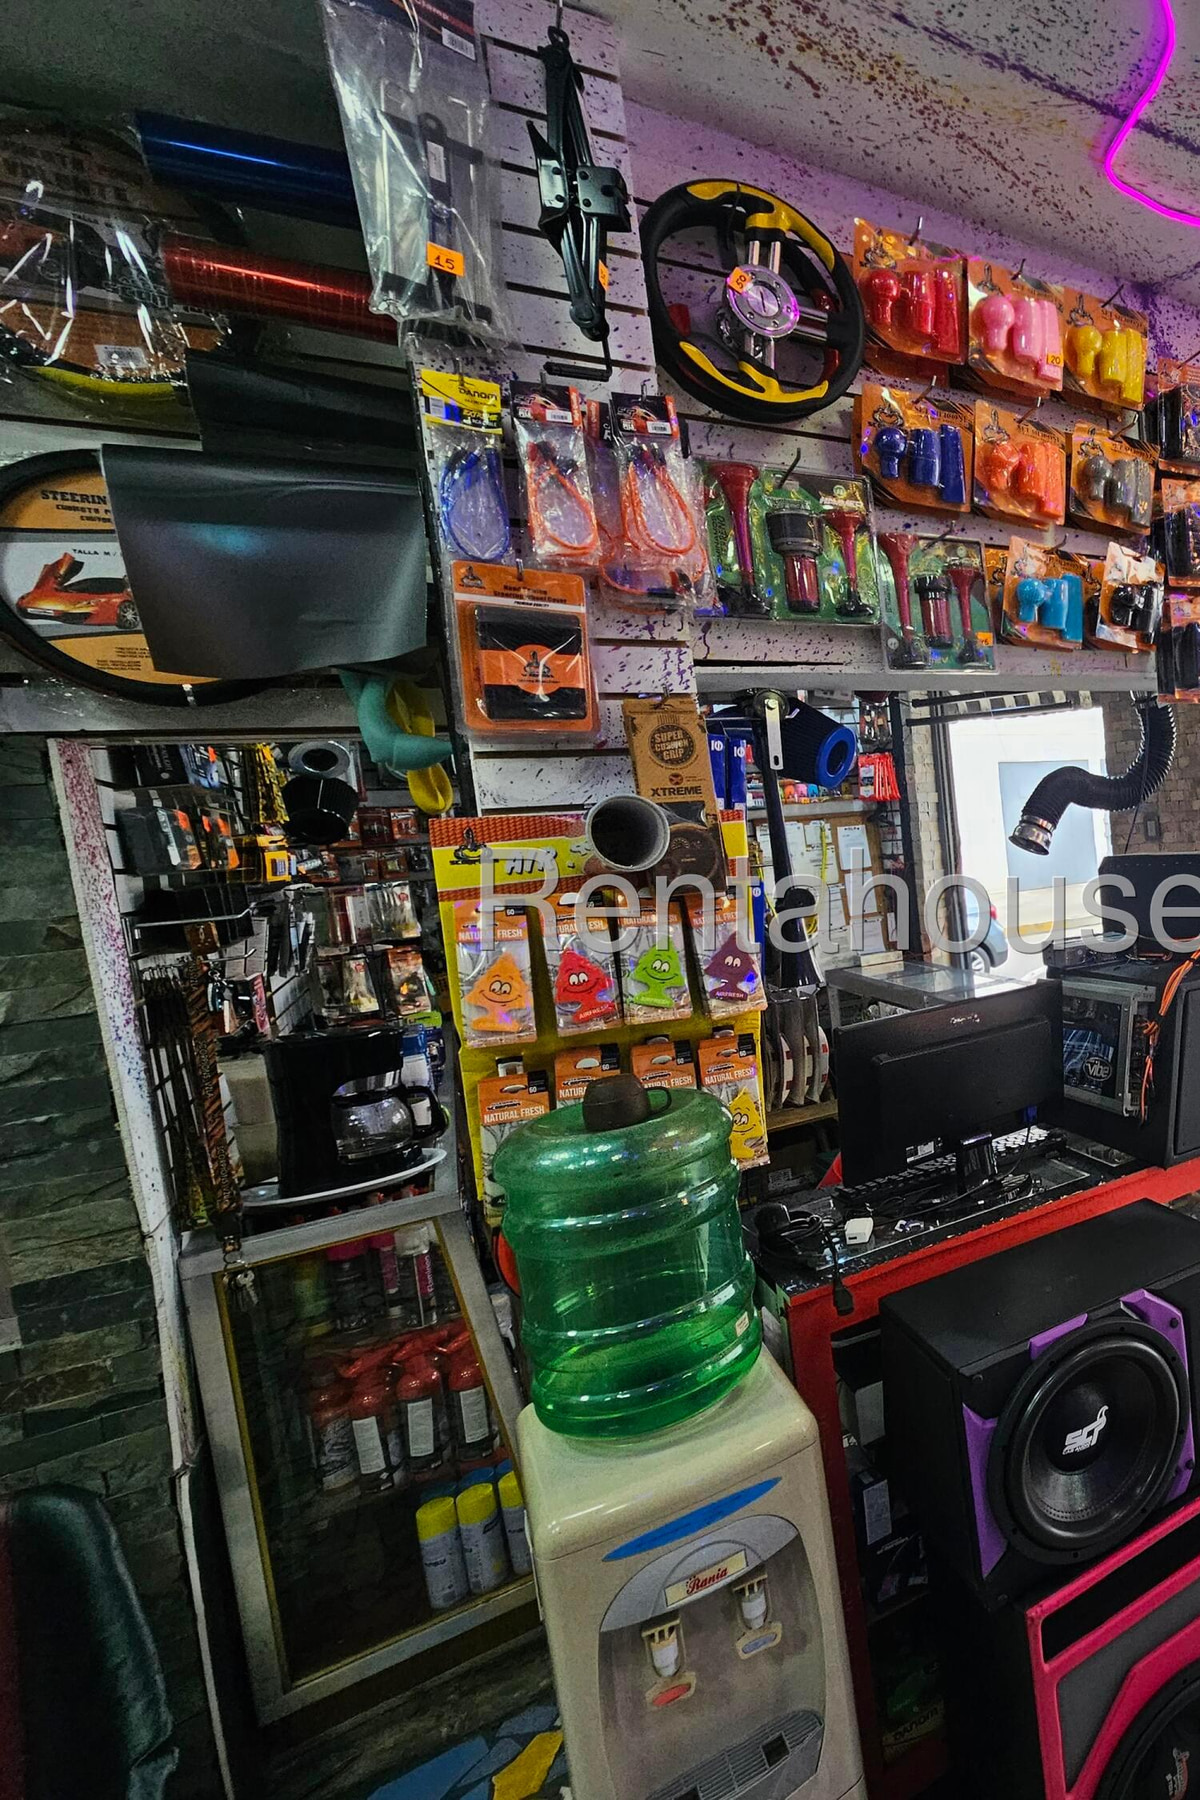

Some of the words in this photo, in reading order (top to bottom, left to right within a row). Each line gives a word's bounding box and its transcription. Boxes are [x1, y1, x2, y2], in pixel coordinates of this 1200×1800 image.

[433, 254, 455, 270] 15
[735, 274, 747, 290] 50
[1050, 355, 1061, 365] 20
[458, 386, 498, 400] DANOM
[41, 489, 108, 506] STEERIN
[72, 548, 99, 556] TALLA
[654, 729, 684, 743] SUPER
[662, 749, 685, 761] GRIP
[651, 785, 703, 797] XTREME
[692, 914, 722, 926] NATAL
[459, 929, 495, 943] NATU
[497, 928, 523, 939] FRESH
[715, 991, 744, 999] AIRFRESH
[704, 1071, 734, 1085] NATURAL
[734, 1065, 754, 1080] FRESH
[1086, 1060, 1110, 1078] vibe
[671, 1075, 692, 1087] FRESH
[559, 1086, 587, 1098] NATURA
[484, 1109, 519, 1124] NATURAL
[520, 1105, 545, 1118] FRESH
[686, 1567, 729, 1595] Rania
